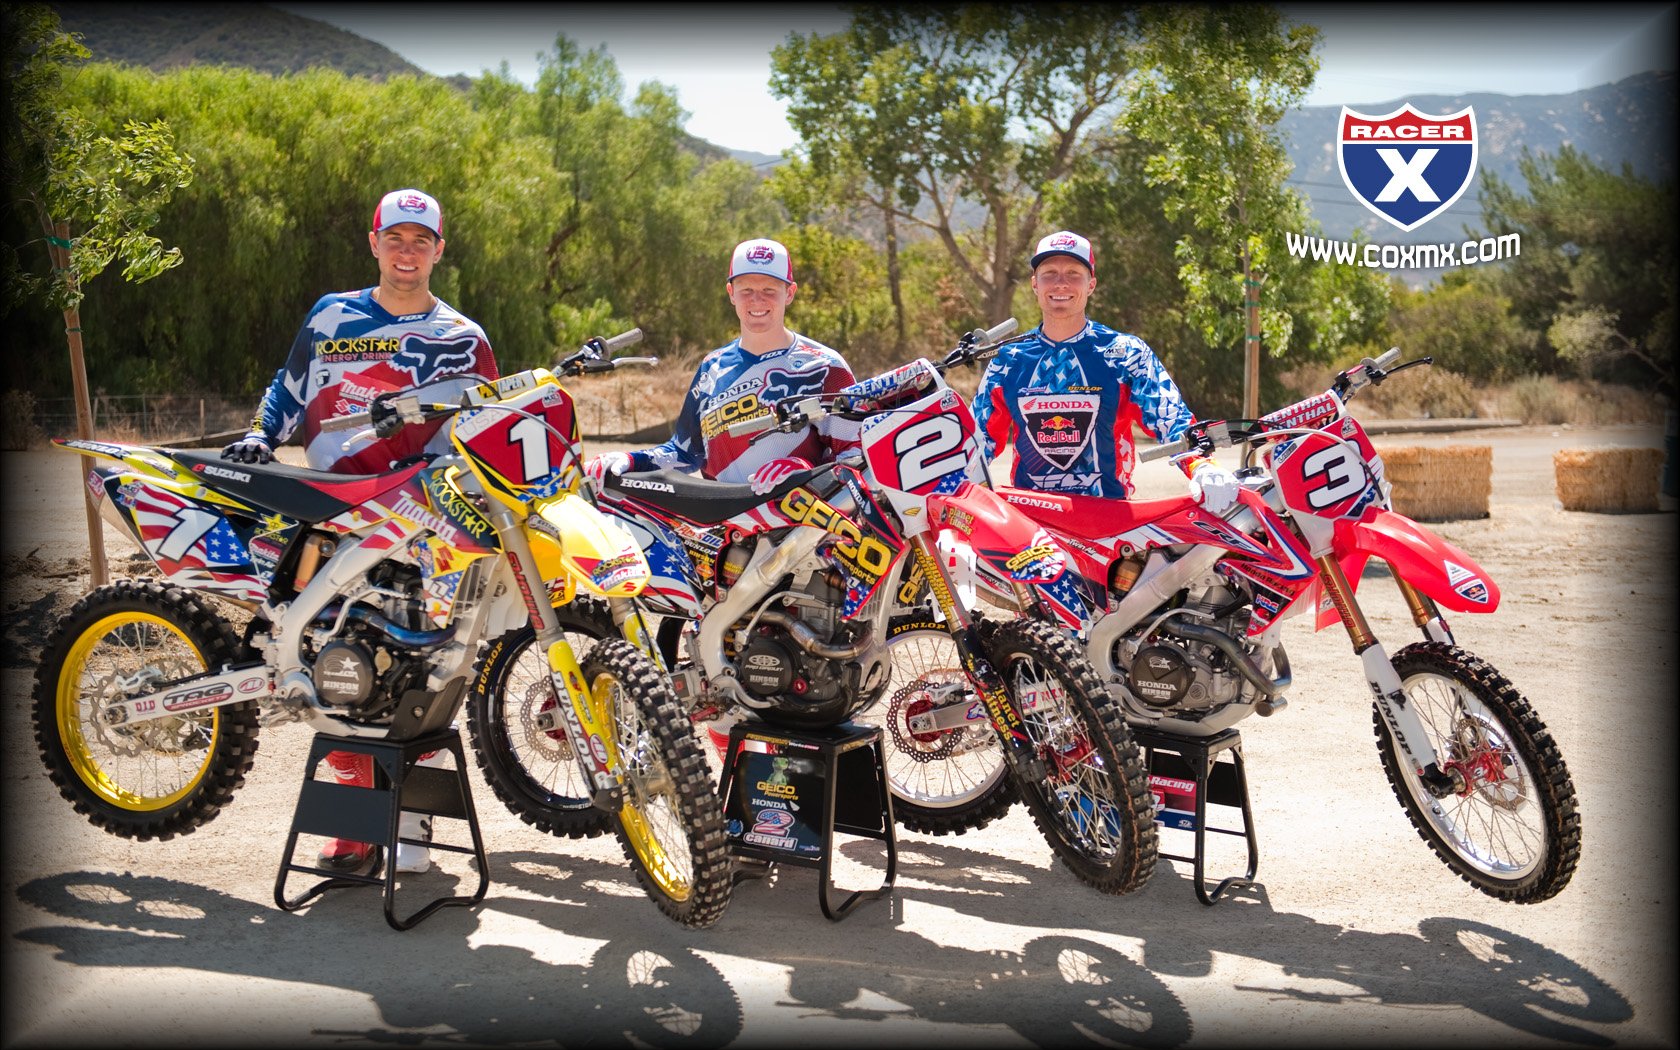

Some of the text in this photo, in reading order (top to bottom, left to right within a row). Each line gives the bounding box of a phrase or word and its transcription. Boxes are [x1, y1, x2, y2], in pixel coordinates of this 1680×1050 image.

[747, 250, 774, 260] USA
[397, 314, 426, 322] FOX
[320, 352, 391, 363] ENERGY DRINK
[759, 350, 784, 361] FOX
[850, 364, 928, 396] RENTHAL
[708, 378, 764, 409] HONDA
[1037, 401, 1094, 410] HONDA
[1037, 430, 1080, 443] Red Bull
[67, 440, 131, 458] DUNLOP
[508, 411, 551, 482] 1
[894, 412, 969, 492] 2
[204, 466, 251, 482] SUZUKI
[1027, 473, 1103, 489] FLY
[1302, 438, 1368, 510] 3
[620, 479, 675, 494] HONDA
[847, 480, 866, 509] HONDA
[1007, 495, 1064, 512] HONDA
[949, 506, 974, 523] planet
[155, 507, 221, 563] 1
[781, 487, 891, 576] GEICO
[949, 517, 973, 536] fitness
[684, 540, 718, 556] DUNLOP
[1005, 544, 1054, 570] GEICO
[831, 547, 876, 585] Powersports
[1240, 563, 1295, 596] Honda Racing
[1255, 594, 1280, 613] HRC
[893, 622, 945, 635] DUNLOP
[477, 641, 503, 696] DUNLOP
[1137, 680, 1178, 691] HONDA
[168, 685, 226, 705] TAG
[551, 671, 596, 771] DUNLOP
[1370, 681, 1412, 755] DUNLOP
[756, 781, 795, 794] GEICO
[1151, 776, 1195, 792] Racing
[764, 790, 798, 800] Powersports
[752, 798, 788, 810] HONDA
[752, 809, 795, 838] 2
[745, 833, 797, 850] canard
